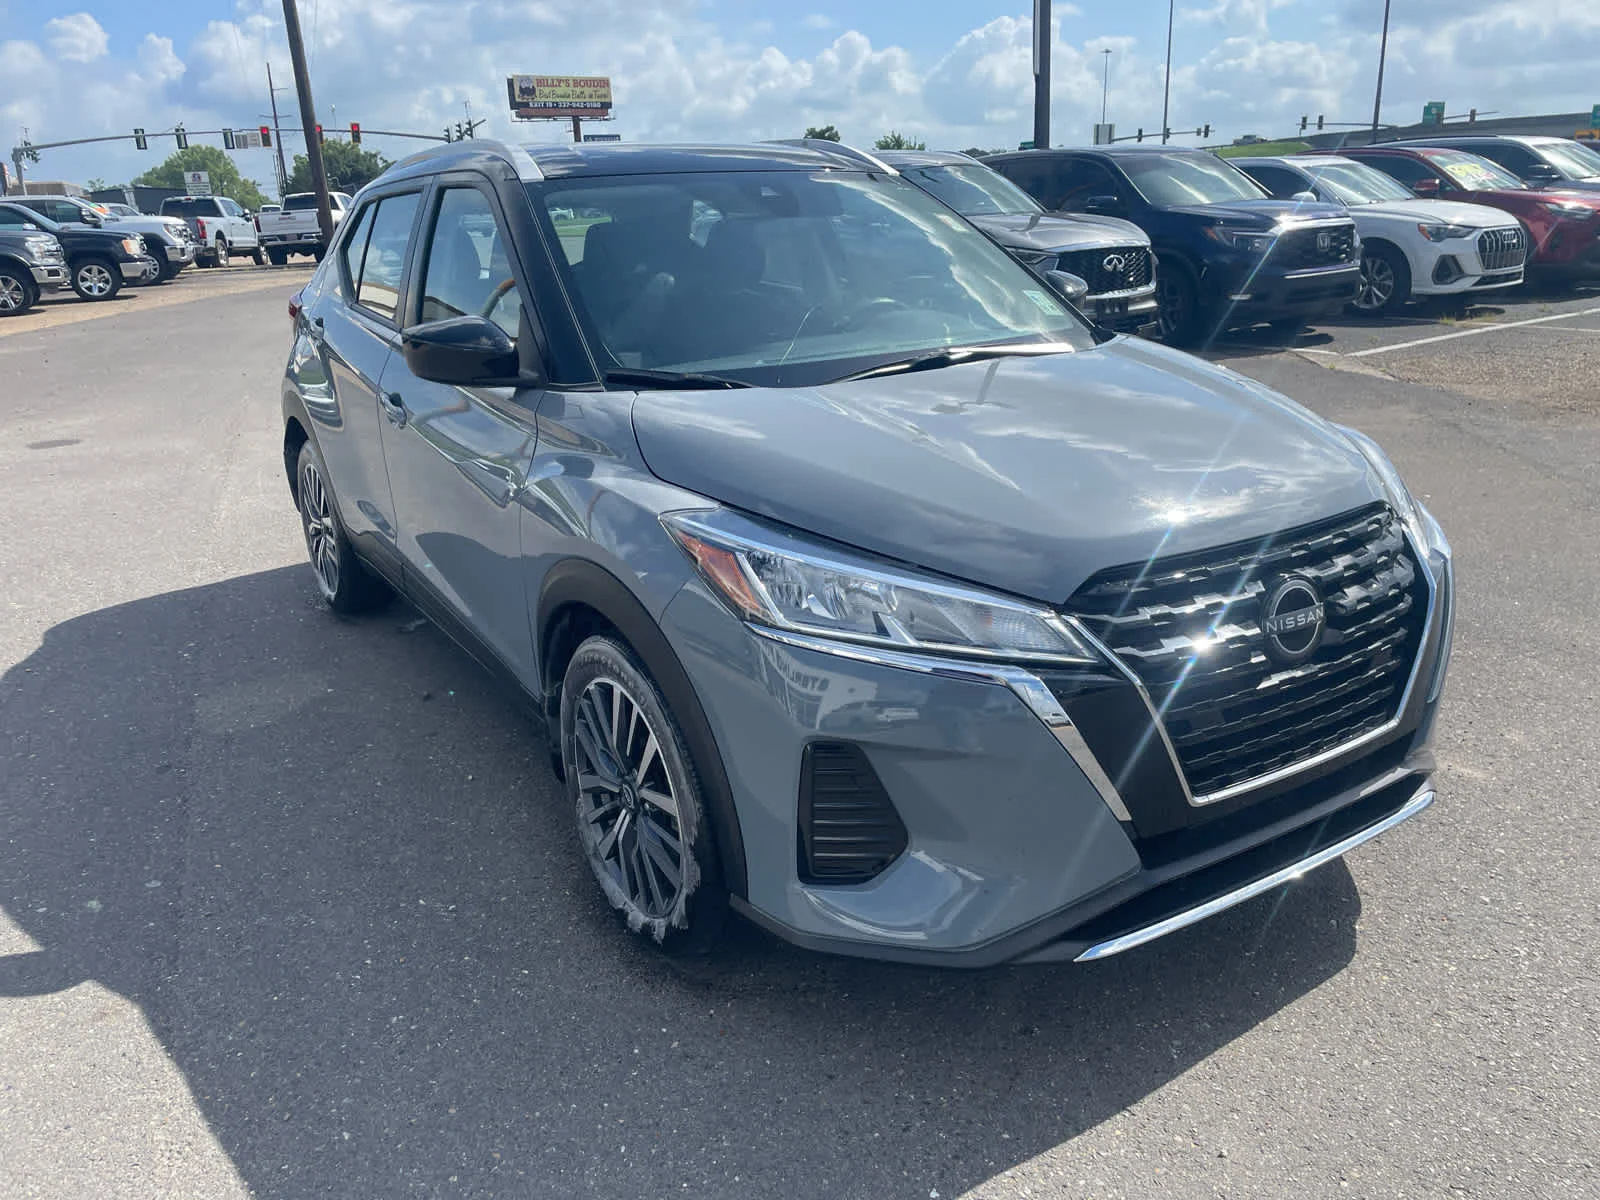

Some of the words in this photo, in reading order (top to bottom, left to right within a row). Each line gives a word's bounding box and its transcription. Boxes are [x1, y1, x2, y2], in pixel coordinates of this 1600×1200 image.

[536, 78, 570, 88] BILLY'S
[573, 79, 609, 89] BOUDIN
[1266, 606, 1324, 633] NISSAN
